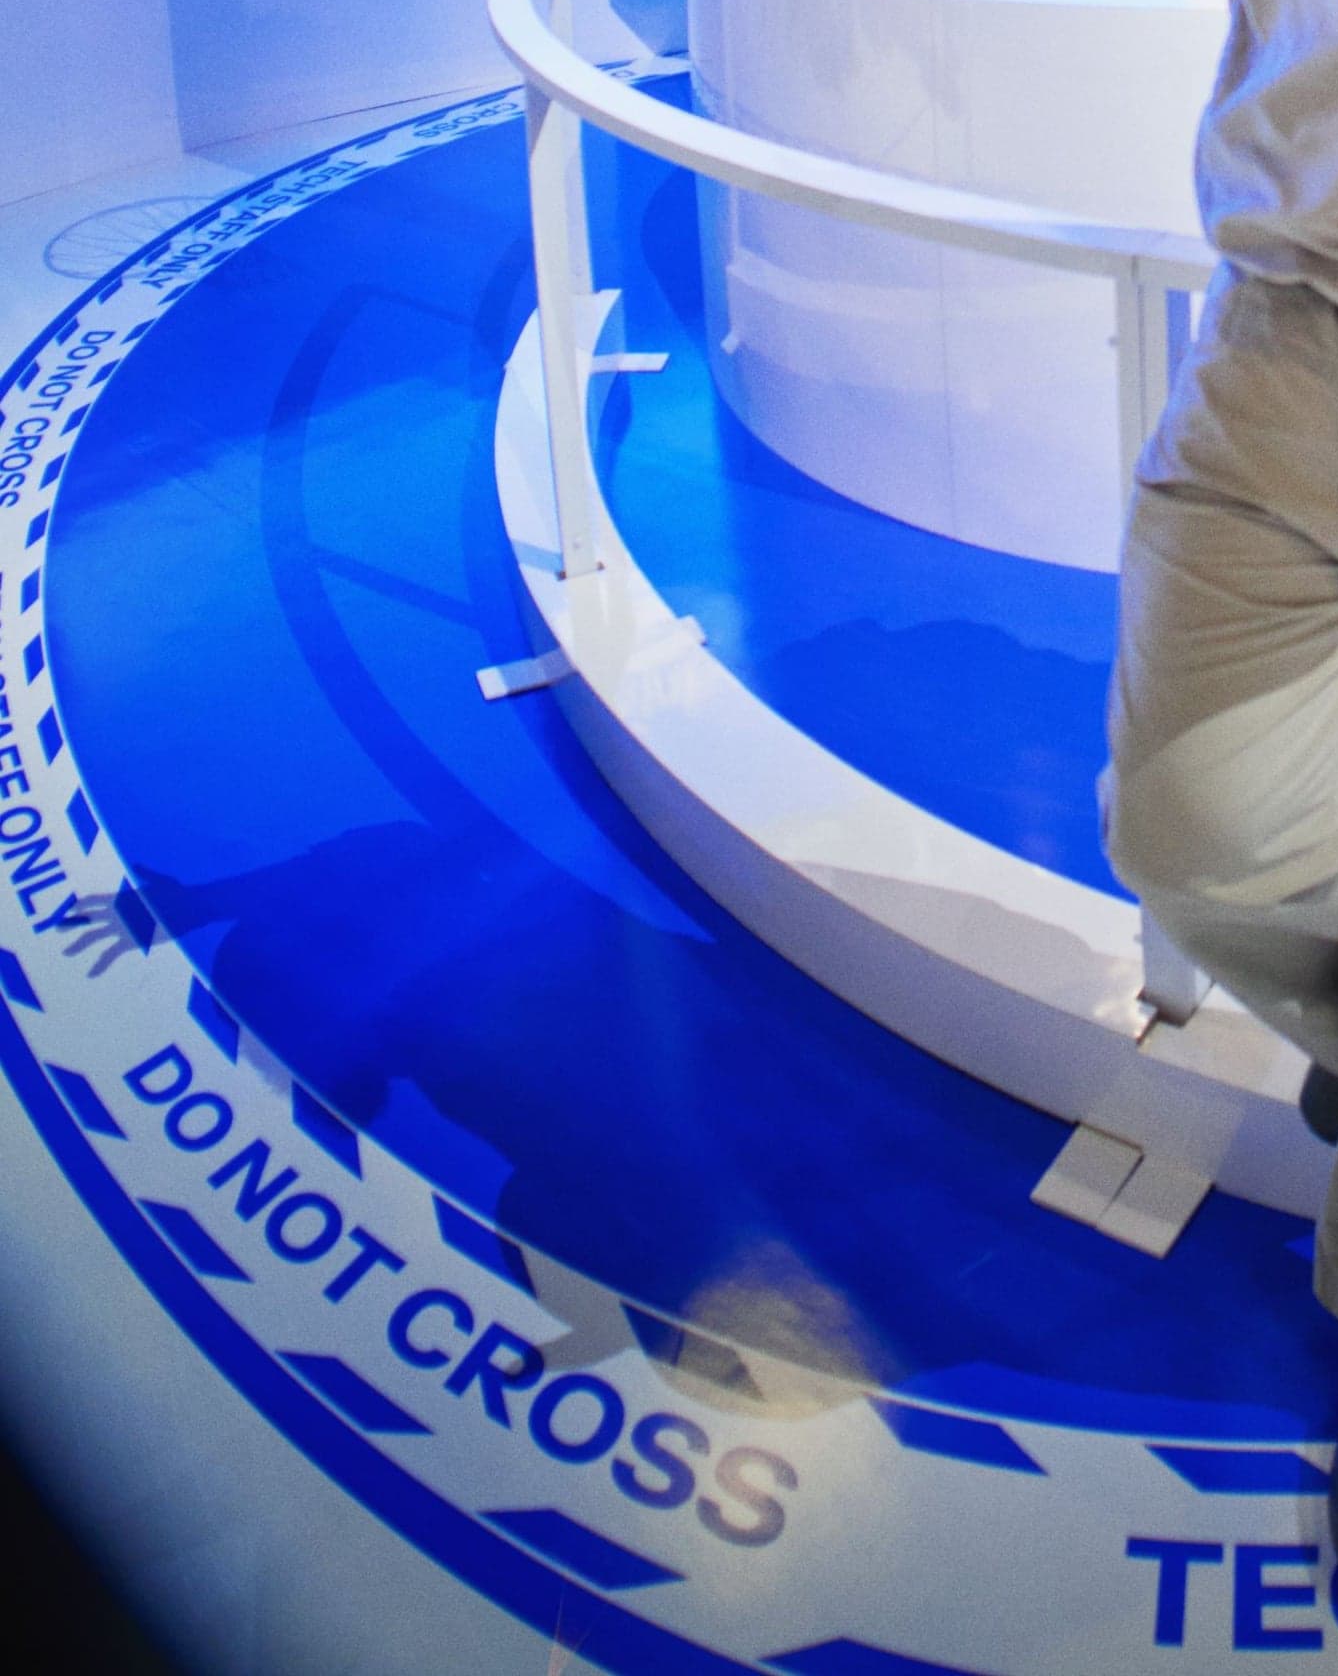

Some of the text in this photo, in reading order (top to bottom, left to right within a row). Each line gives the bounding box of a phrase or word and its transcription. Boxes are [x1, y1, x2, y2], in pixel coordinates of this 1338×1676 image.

[140, 160, 368, 290] TECH STAFF ONLY
[28, 365, 88, 412] NOT
[66, 330, 117, 361] DO
[122, 1043, 800, 1548] DO NOT CROSS
